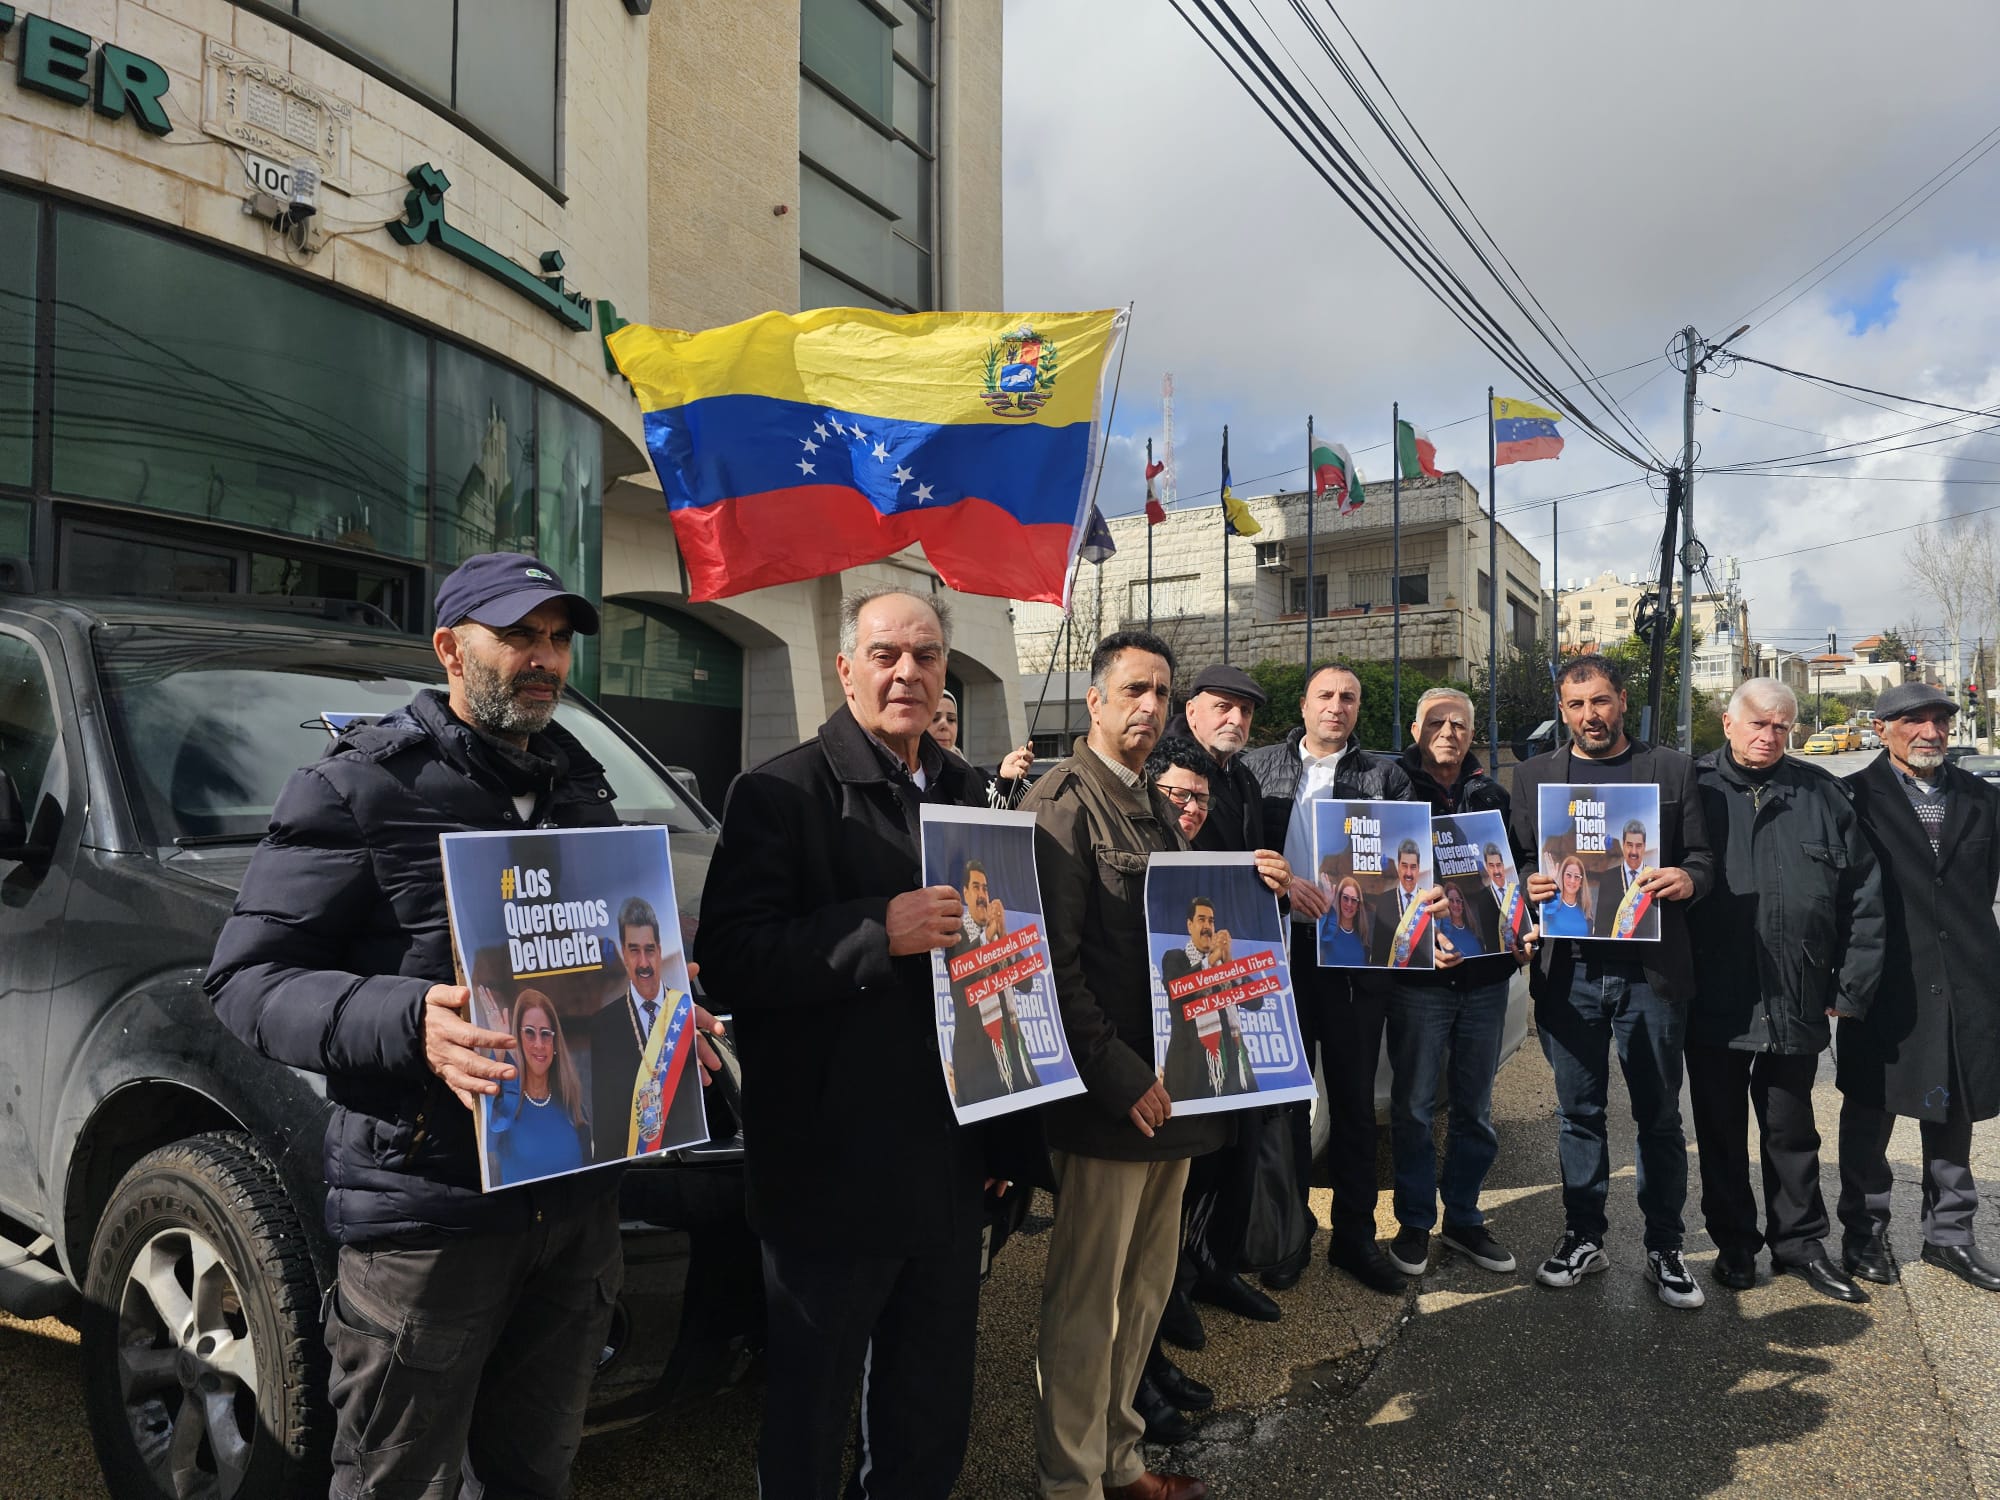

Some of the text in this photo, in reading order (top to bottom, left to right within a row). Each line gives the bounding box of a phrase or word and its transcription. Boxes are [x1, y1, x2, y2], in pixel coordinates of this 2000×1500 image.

[0, 3, 173, 136] ER
[1568, 799, 1605, 818] #Bring
[1344, 816, 1381, 836] #Bring
[1575, 817, 1606, 834] Them
[1351, 835, 1381, 853] Them
[1432, 831, 1454, 846] #Los
[1576, 834, 1606, 850] Back
[1353, 853, 1382, 871] Back
[1435, 844, 1480, 861] Queremos
[1439, 858, 1479, 875] DeVuelta
[501, 865, 551, 900] #Los
[504, 900, 609, 938] Queremos
[508, 932, 602, 972] DeVuelta
[951, 930, 1039, 977] Viva Venezuela libre
[967, 956, 1043, 1004] عاشت فنزويلا الحرة
[1170, 956, 1274, 996] Viva Venezuela libre
[1186, 979, 1279, 1019] عاشت فنزويلا الحرة
